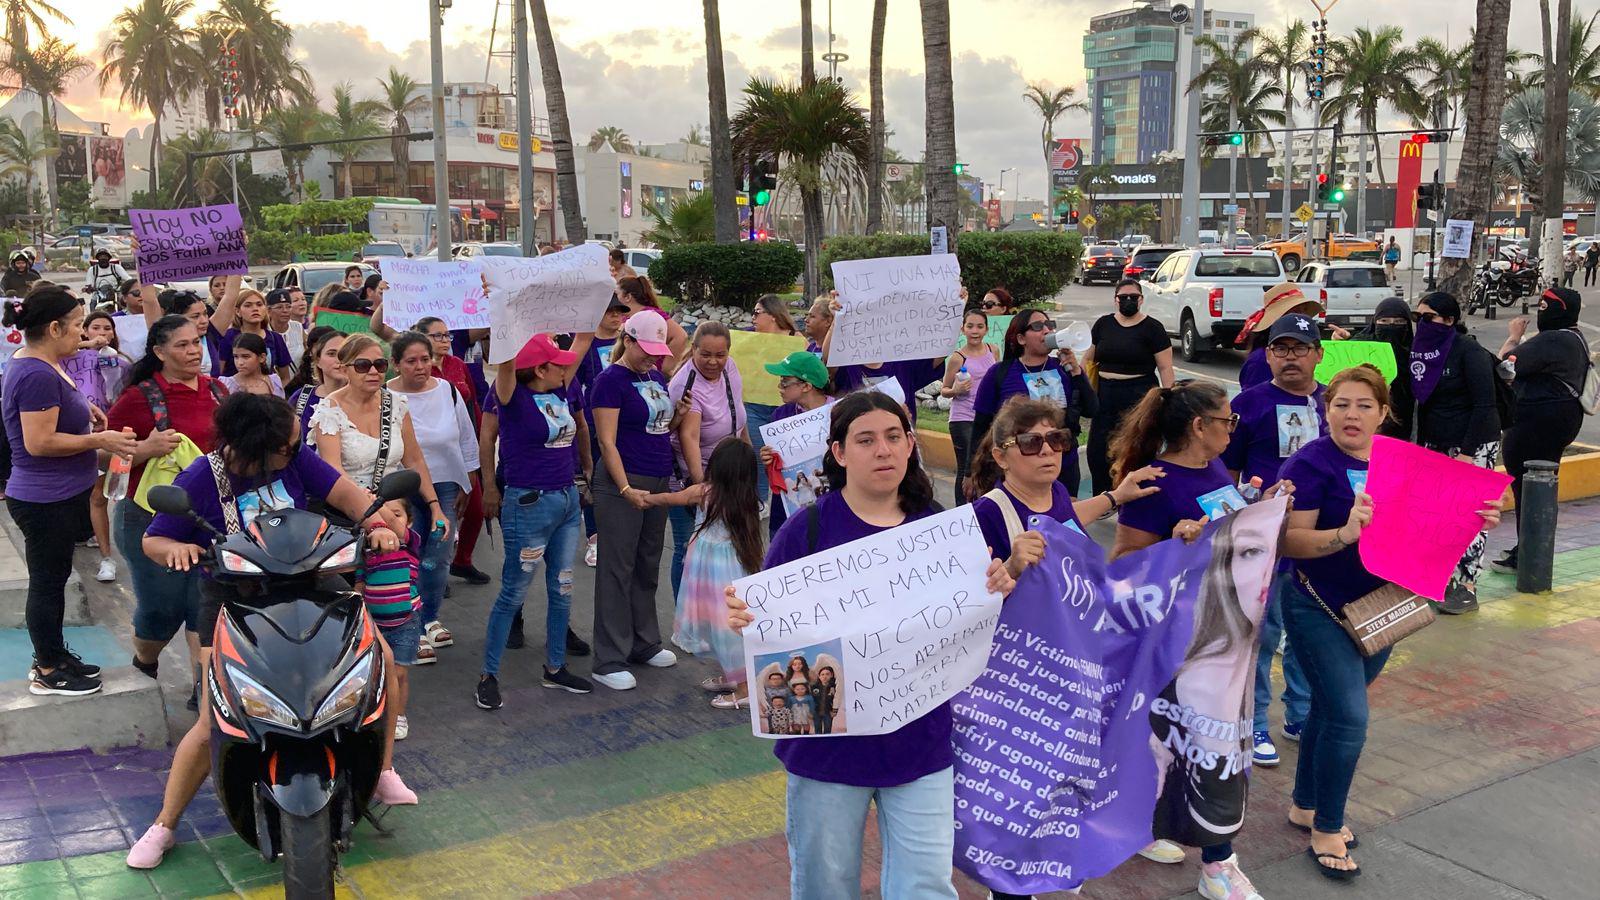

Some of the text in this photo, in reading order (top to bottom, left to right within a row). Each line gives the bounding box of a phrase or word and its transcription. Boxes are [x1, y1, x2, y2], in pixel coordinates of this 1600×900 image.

[138, 209, 222, 238] Hoy NO
[138, 252, 170, 266] NOS
[217, 239, 247, 253] ANA
[843, 272, 875, 295] NI
[888, 265, 925, 286] UNA
[406, 302, 426, 313] UNA
[836, 321, 953, 353] JUSTICIA PARA
[851, 337, 956, 361] ANA BEATRIZ
[1424, 349, 1440, 360] SOLA
[382, 412, 391, 422] Y
[767, 411, 825, 437] Queremos
[381, 423, 391, 450] LOLA
[776, 426, 828, 457] PARA
[372, 457, 386, 492] BIMBA
[745, 514, 981, 613] QUEREMOS JUSTICIA
[756, 551, 968, 642] PARA MI MAMÁ
[1062, 556, 1096, 620] Soy
[848, 590, 985, 659] VICTOR
[995, 623, 1022, 642] Fui
[1366, 600, 1417, 634] STEVE MADDEN
[854, 662, 906, 692] NOS
[854, 646, 968, 712] A NUESTRA
[1001, 649, 1029, 669] día
[1028, 662, 1081, 694] jueves
[879, 679, 953, 728] MADRE
[983, 668, 1070, 711] rrebatada
[953, 702, 1008, 731] crimen
[984, 738, 998, 752] y
[1000, 743, 1065, 782] agonice
[1163, 725, 1219, 771] Nos
[953, 772, 1005, 801] padre
[1005, 797, 1020, 811] y
[972, 805, 1004, 825] que
[1006, 821, 1031, 837] mi
[965, 845, 1072, 879] EXIGO JUSTICIA
